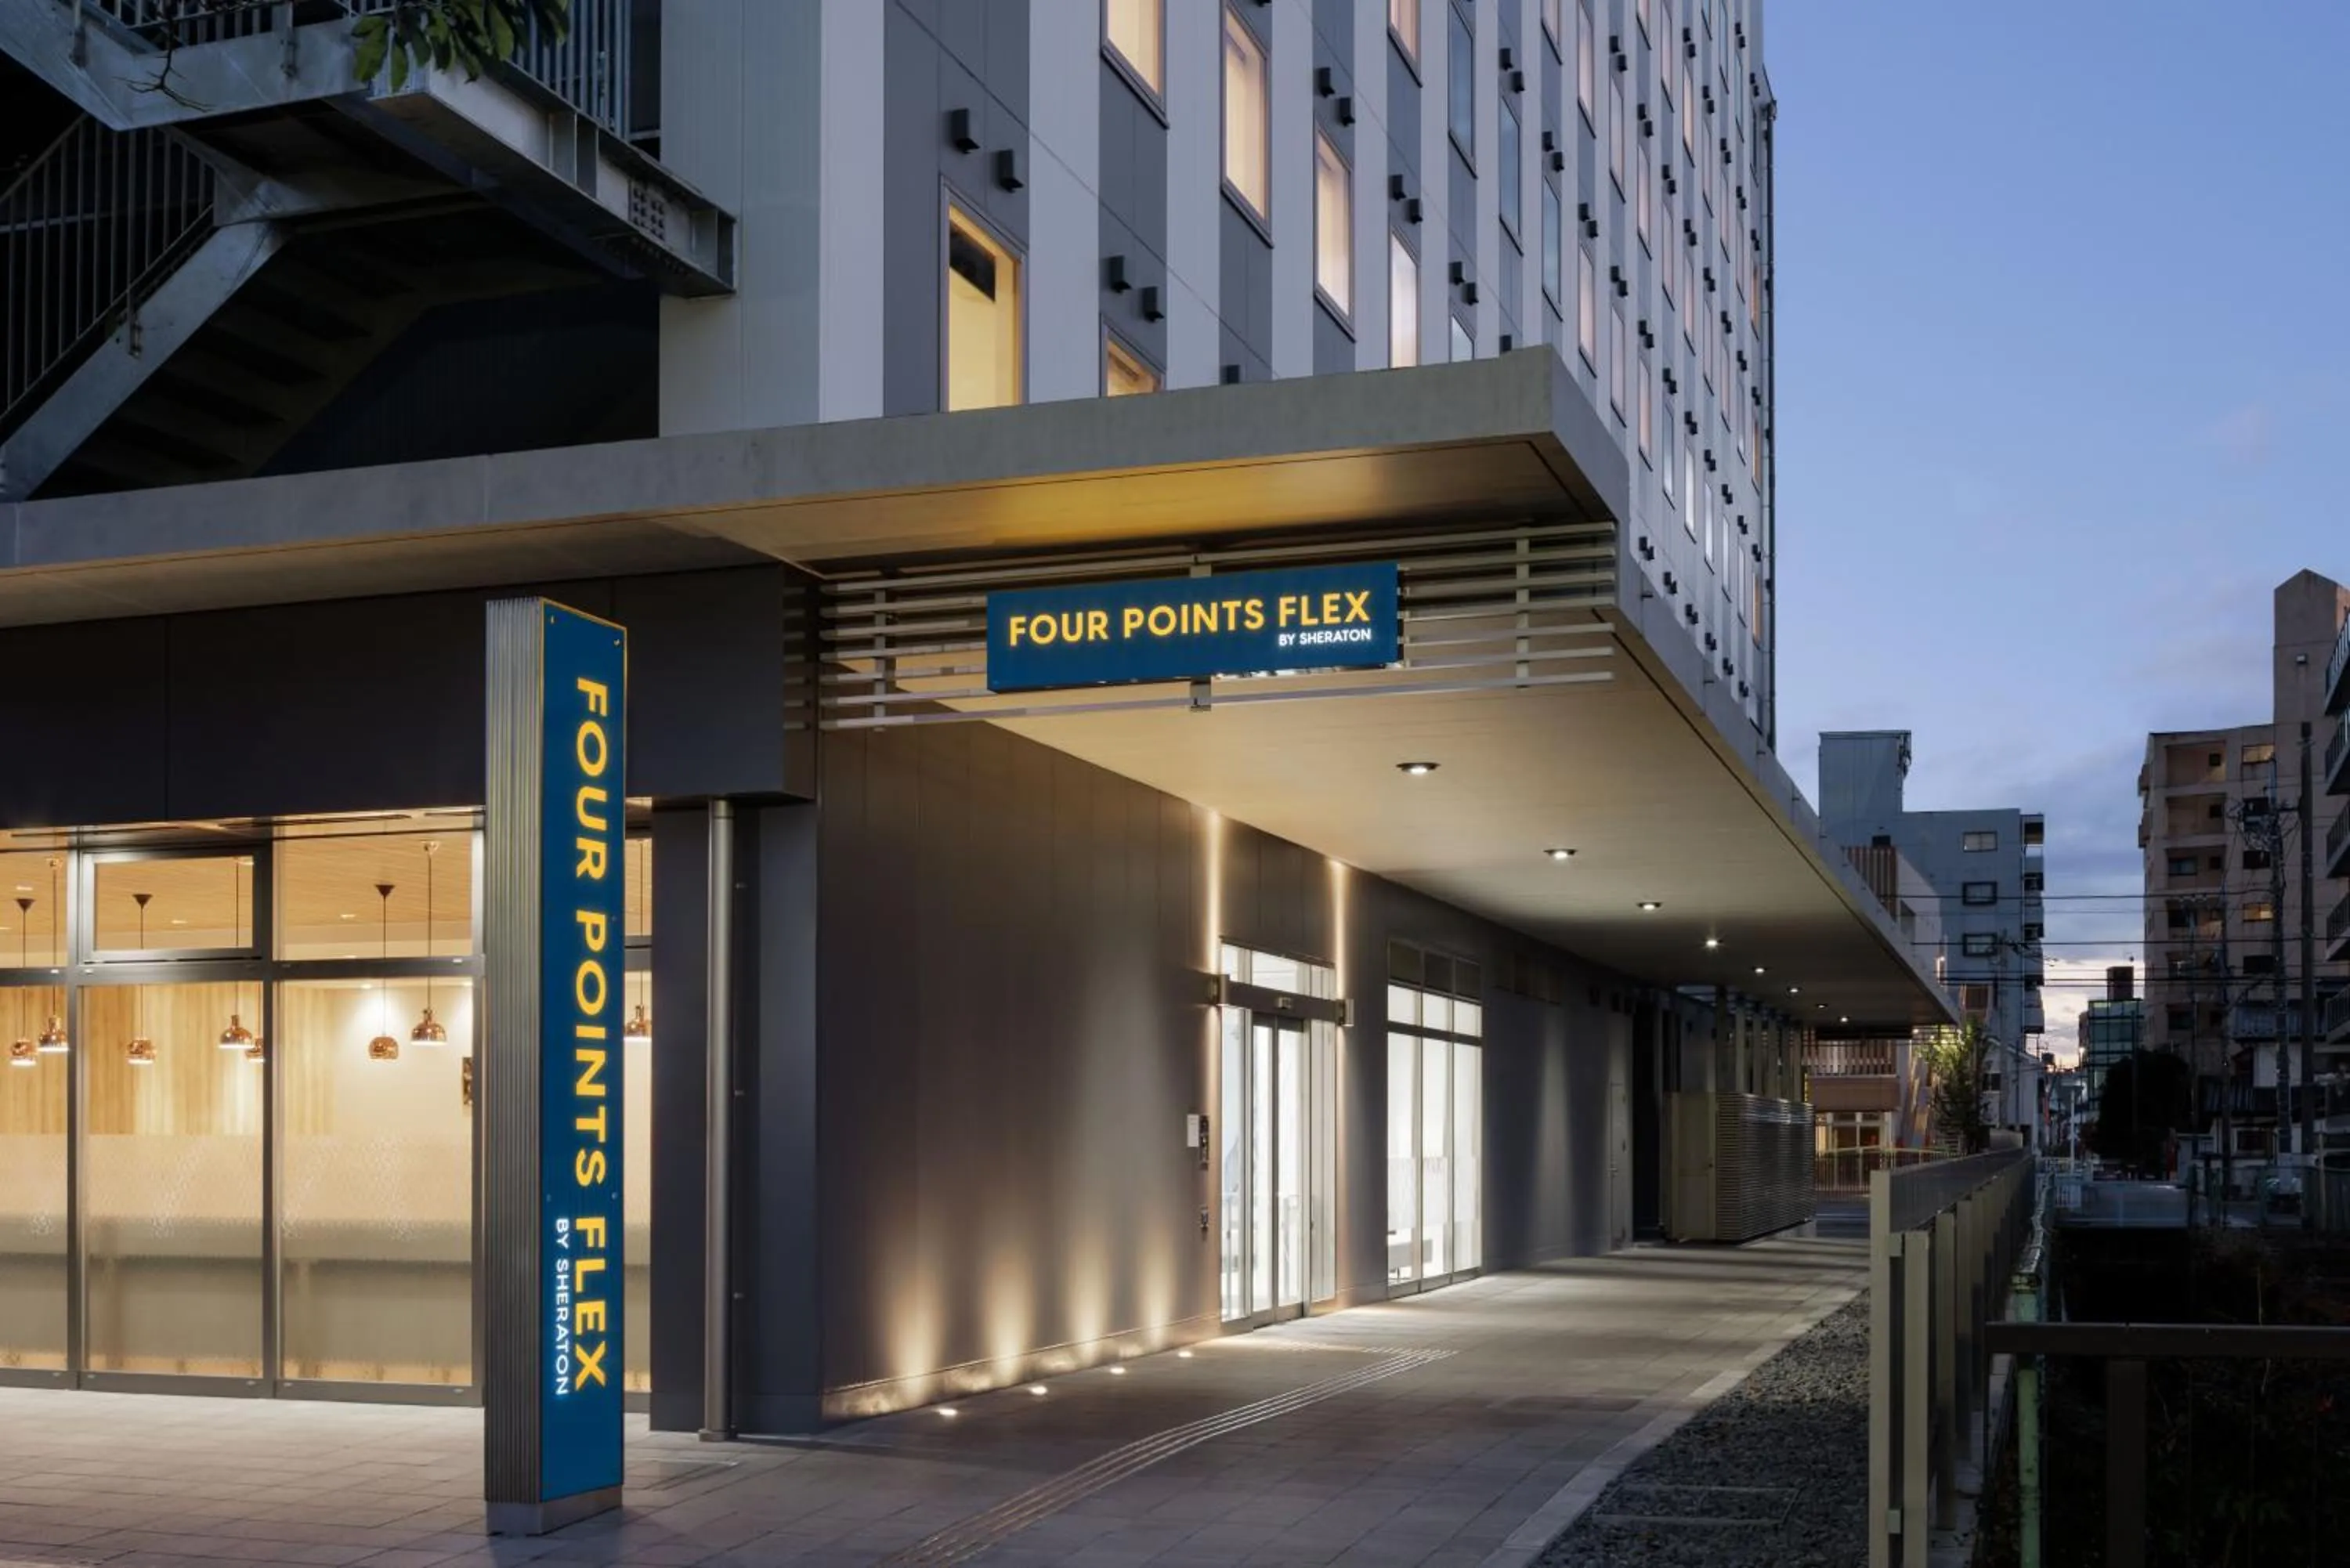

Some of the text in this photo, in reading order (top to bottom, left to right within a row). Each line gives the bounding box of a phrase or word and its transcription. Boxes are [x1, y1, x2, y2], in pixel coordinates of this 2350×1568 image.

[1010, 591, 1370, 646] FOUR POINTS FLEX
[1278, 627, 1372, 647] BY SHERATON
[575, 677, 607, 1390] FOUR POINTS FLEX
[555, 1218, 569, 1395] BY SHERATON
